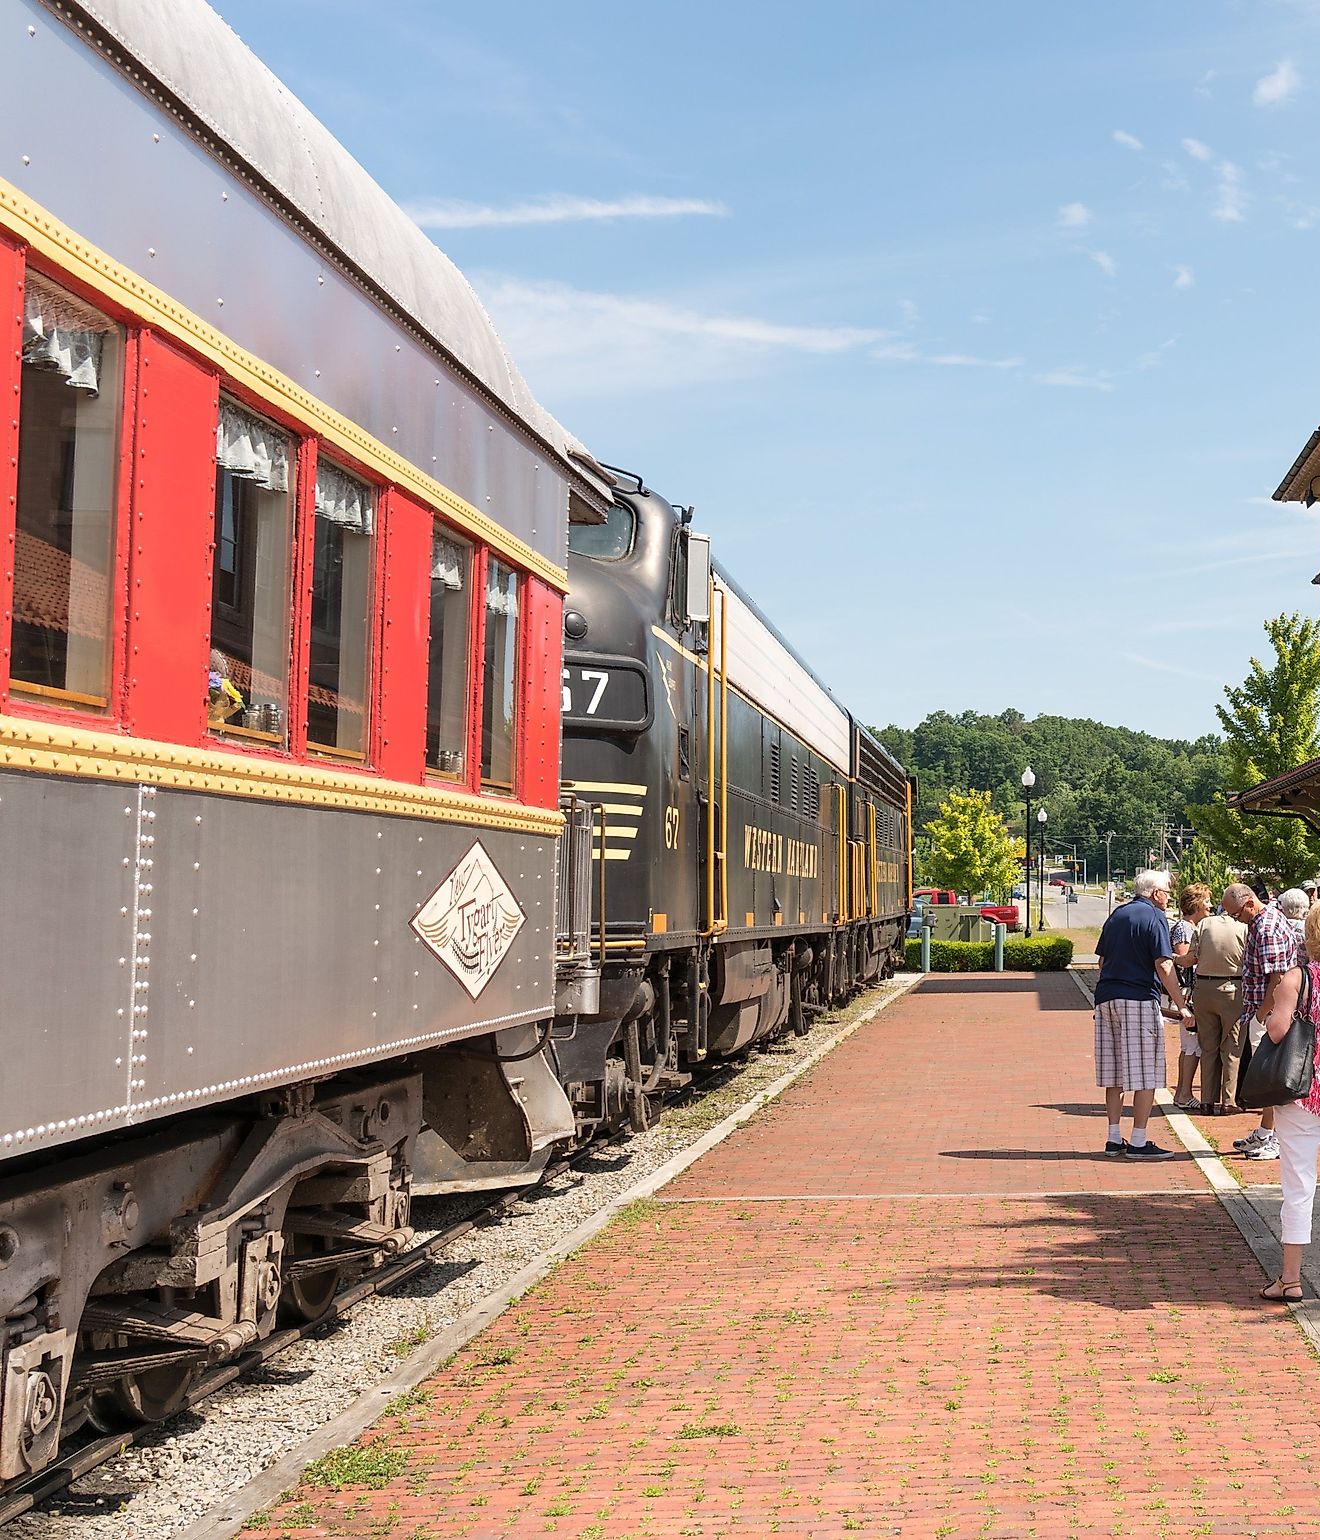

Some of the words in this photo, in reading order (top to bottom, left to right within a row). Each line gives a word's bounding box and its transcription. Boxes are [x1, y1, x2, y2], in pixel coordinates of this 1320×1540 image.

[665, 805, 680, 850] 67
[744, 824, 783, 873] WESTERN
[457, 892, 504, 951] Tygart
[477, 923, 506, 976] Flyer
